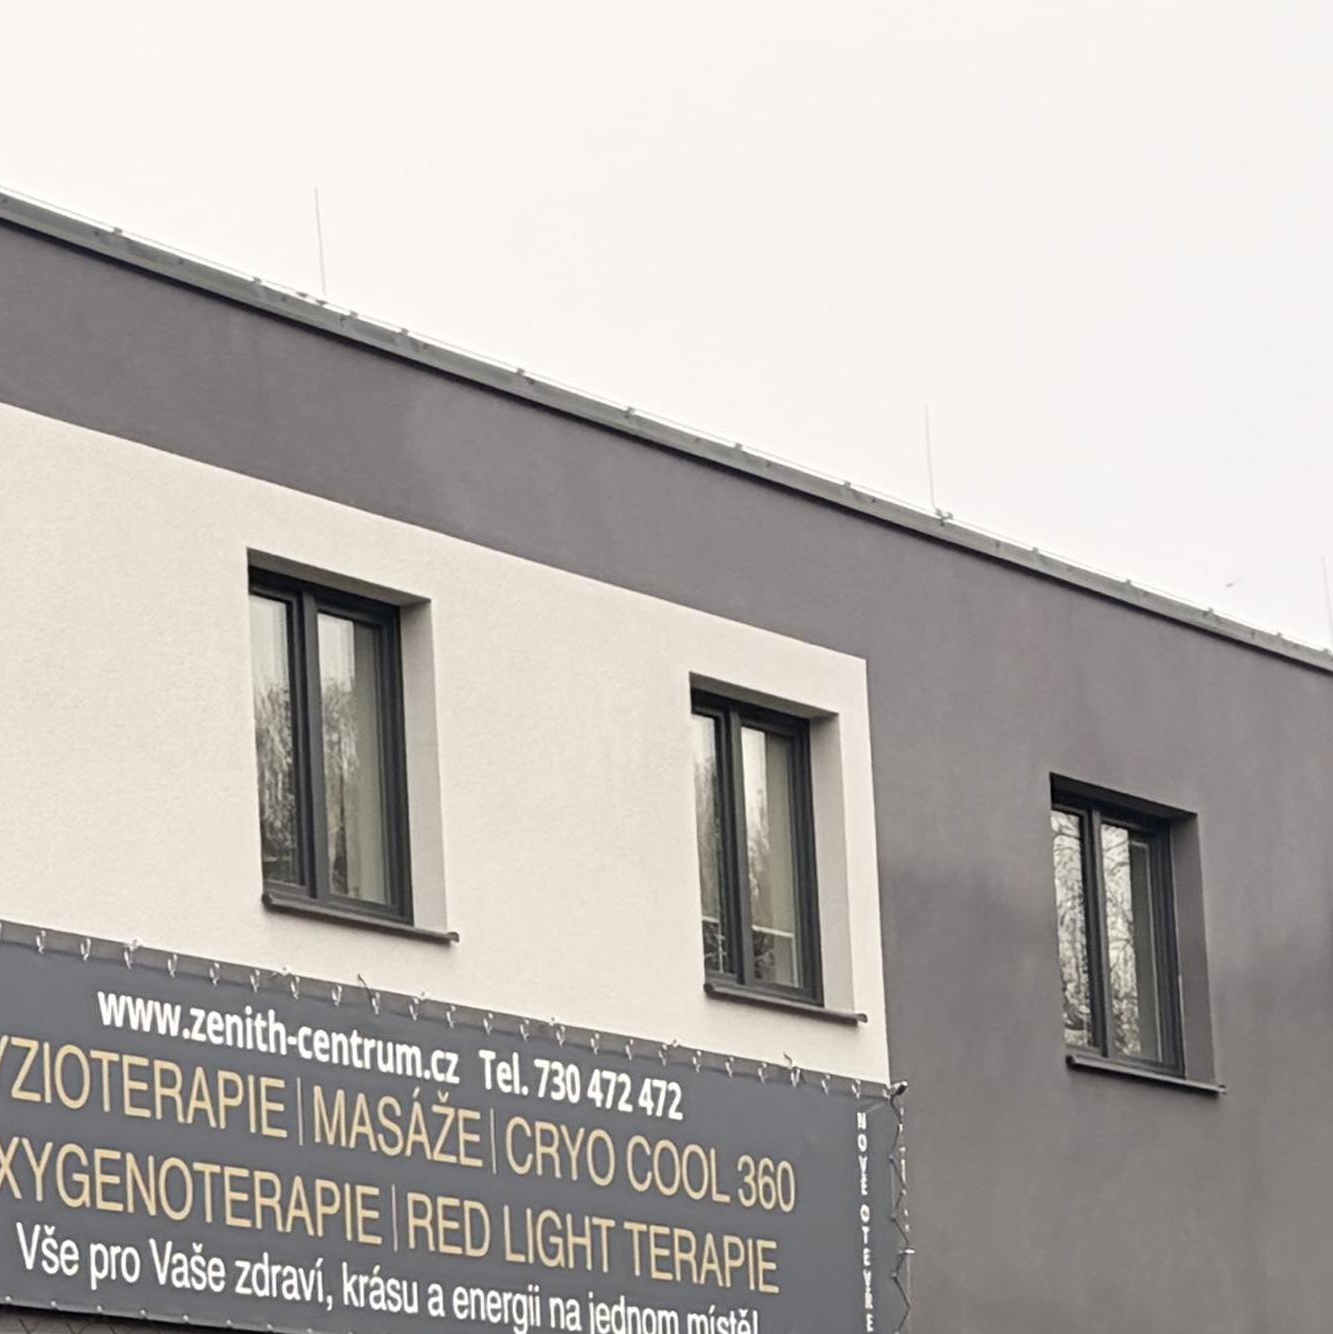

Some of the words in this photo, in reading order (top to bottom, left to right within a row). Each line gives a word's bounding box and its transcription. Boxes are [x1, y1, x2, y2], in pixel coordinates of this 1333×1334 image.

[97, 990, 461, 1085] www.zenith-centrum.cz
[478, 1049, 529, 1096] Tel.
[533, 1058, 581, 1104] 730
[586, 1068, 633, 1113] 472
[637, 1077, 684, 1121] 472
[312, 1086, 484, 1168] MASÁŽE
[505, 1116, 616, 1186] CRYO
[626, 1135, 731, 1203] COOL
[737, 1154, 796, 1213] 360
[15, 1221, 80, 1276] Vše
[89, 1243, 141, 1291] pro
[148, 1238, 226, 1293] Vaše
[234, 1251, 333, 1311] zdraví,
[341, 1261, 419, 1314] krásu
[427, 1283, 446, 1317] a
[548, 1297, 582, 1332] na
[407, 1192, 491, 1257] RED
[503, 1204, 616, 1273] LIGHT
[623, 1221, 780, 1294] TERAPIE
